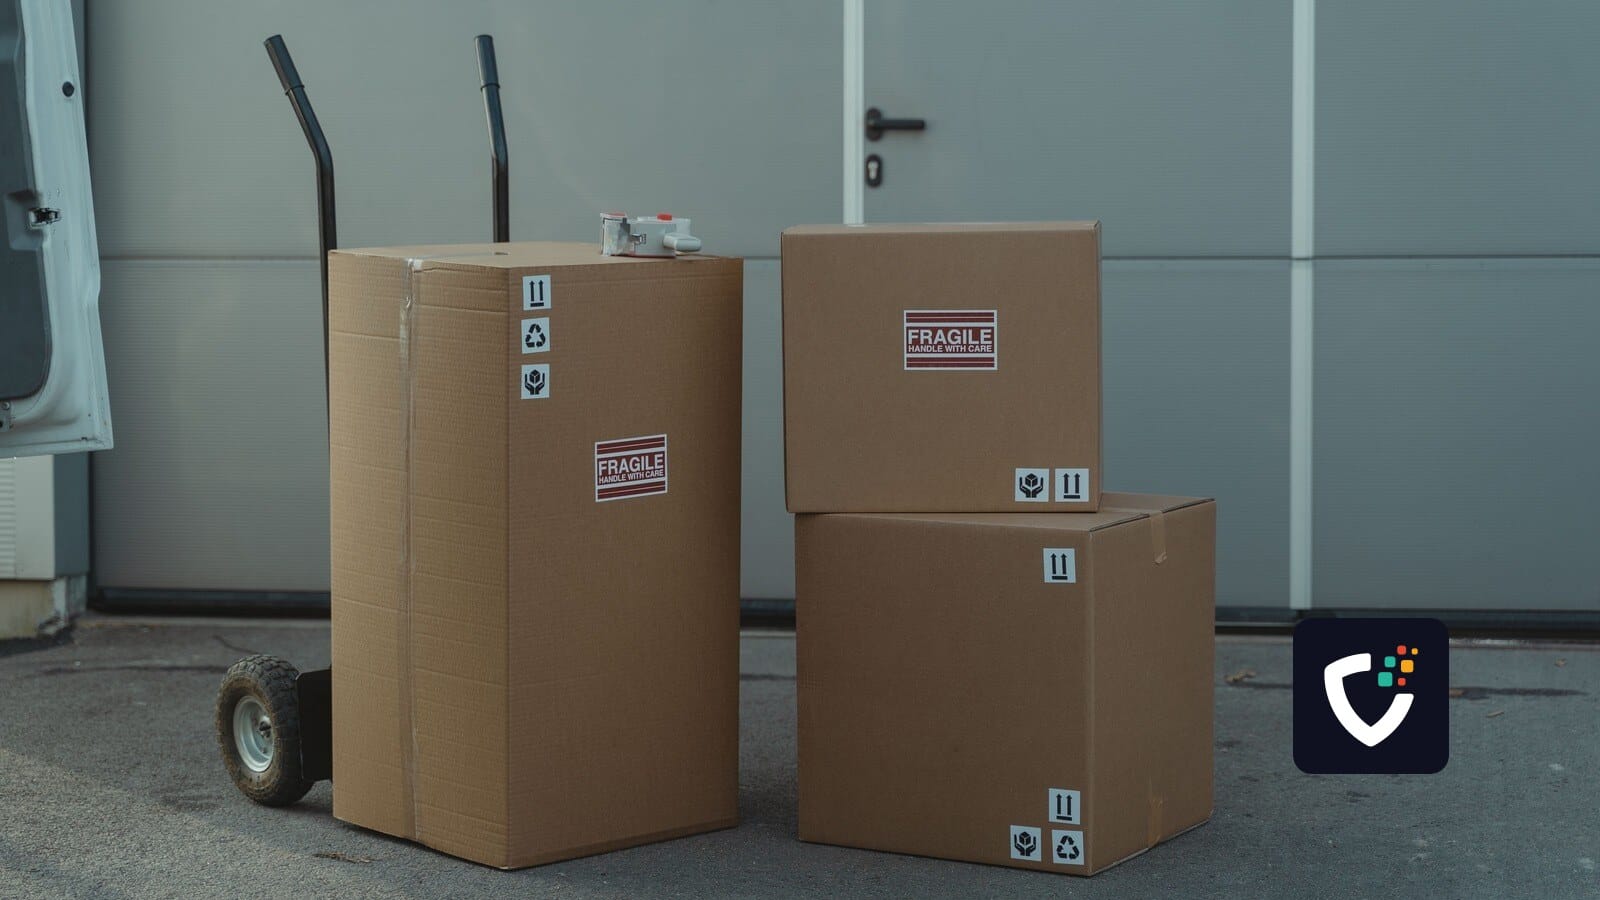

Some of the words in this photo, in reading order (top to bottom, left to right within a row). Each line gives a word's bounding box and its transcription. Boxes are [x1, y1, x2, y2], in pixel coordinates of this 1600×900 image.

[908, 329, 992, 345] FRAGILE
[908, 345, 943, 353] HANDLE
[945, 345, 966, 353] WITH
[968, 345, 992, 353] CARE
[598, 454, 664, 476] FRAGILE
[598, 474, 626, 484] HANDLE
[627, 471, 644, 481] WITH
[645, 469, 664, 478] CARE
